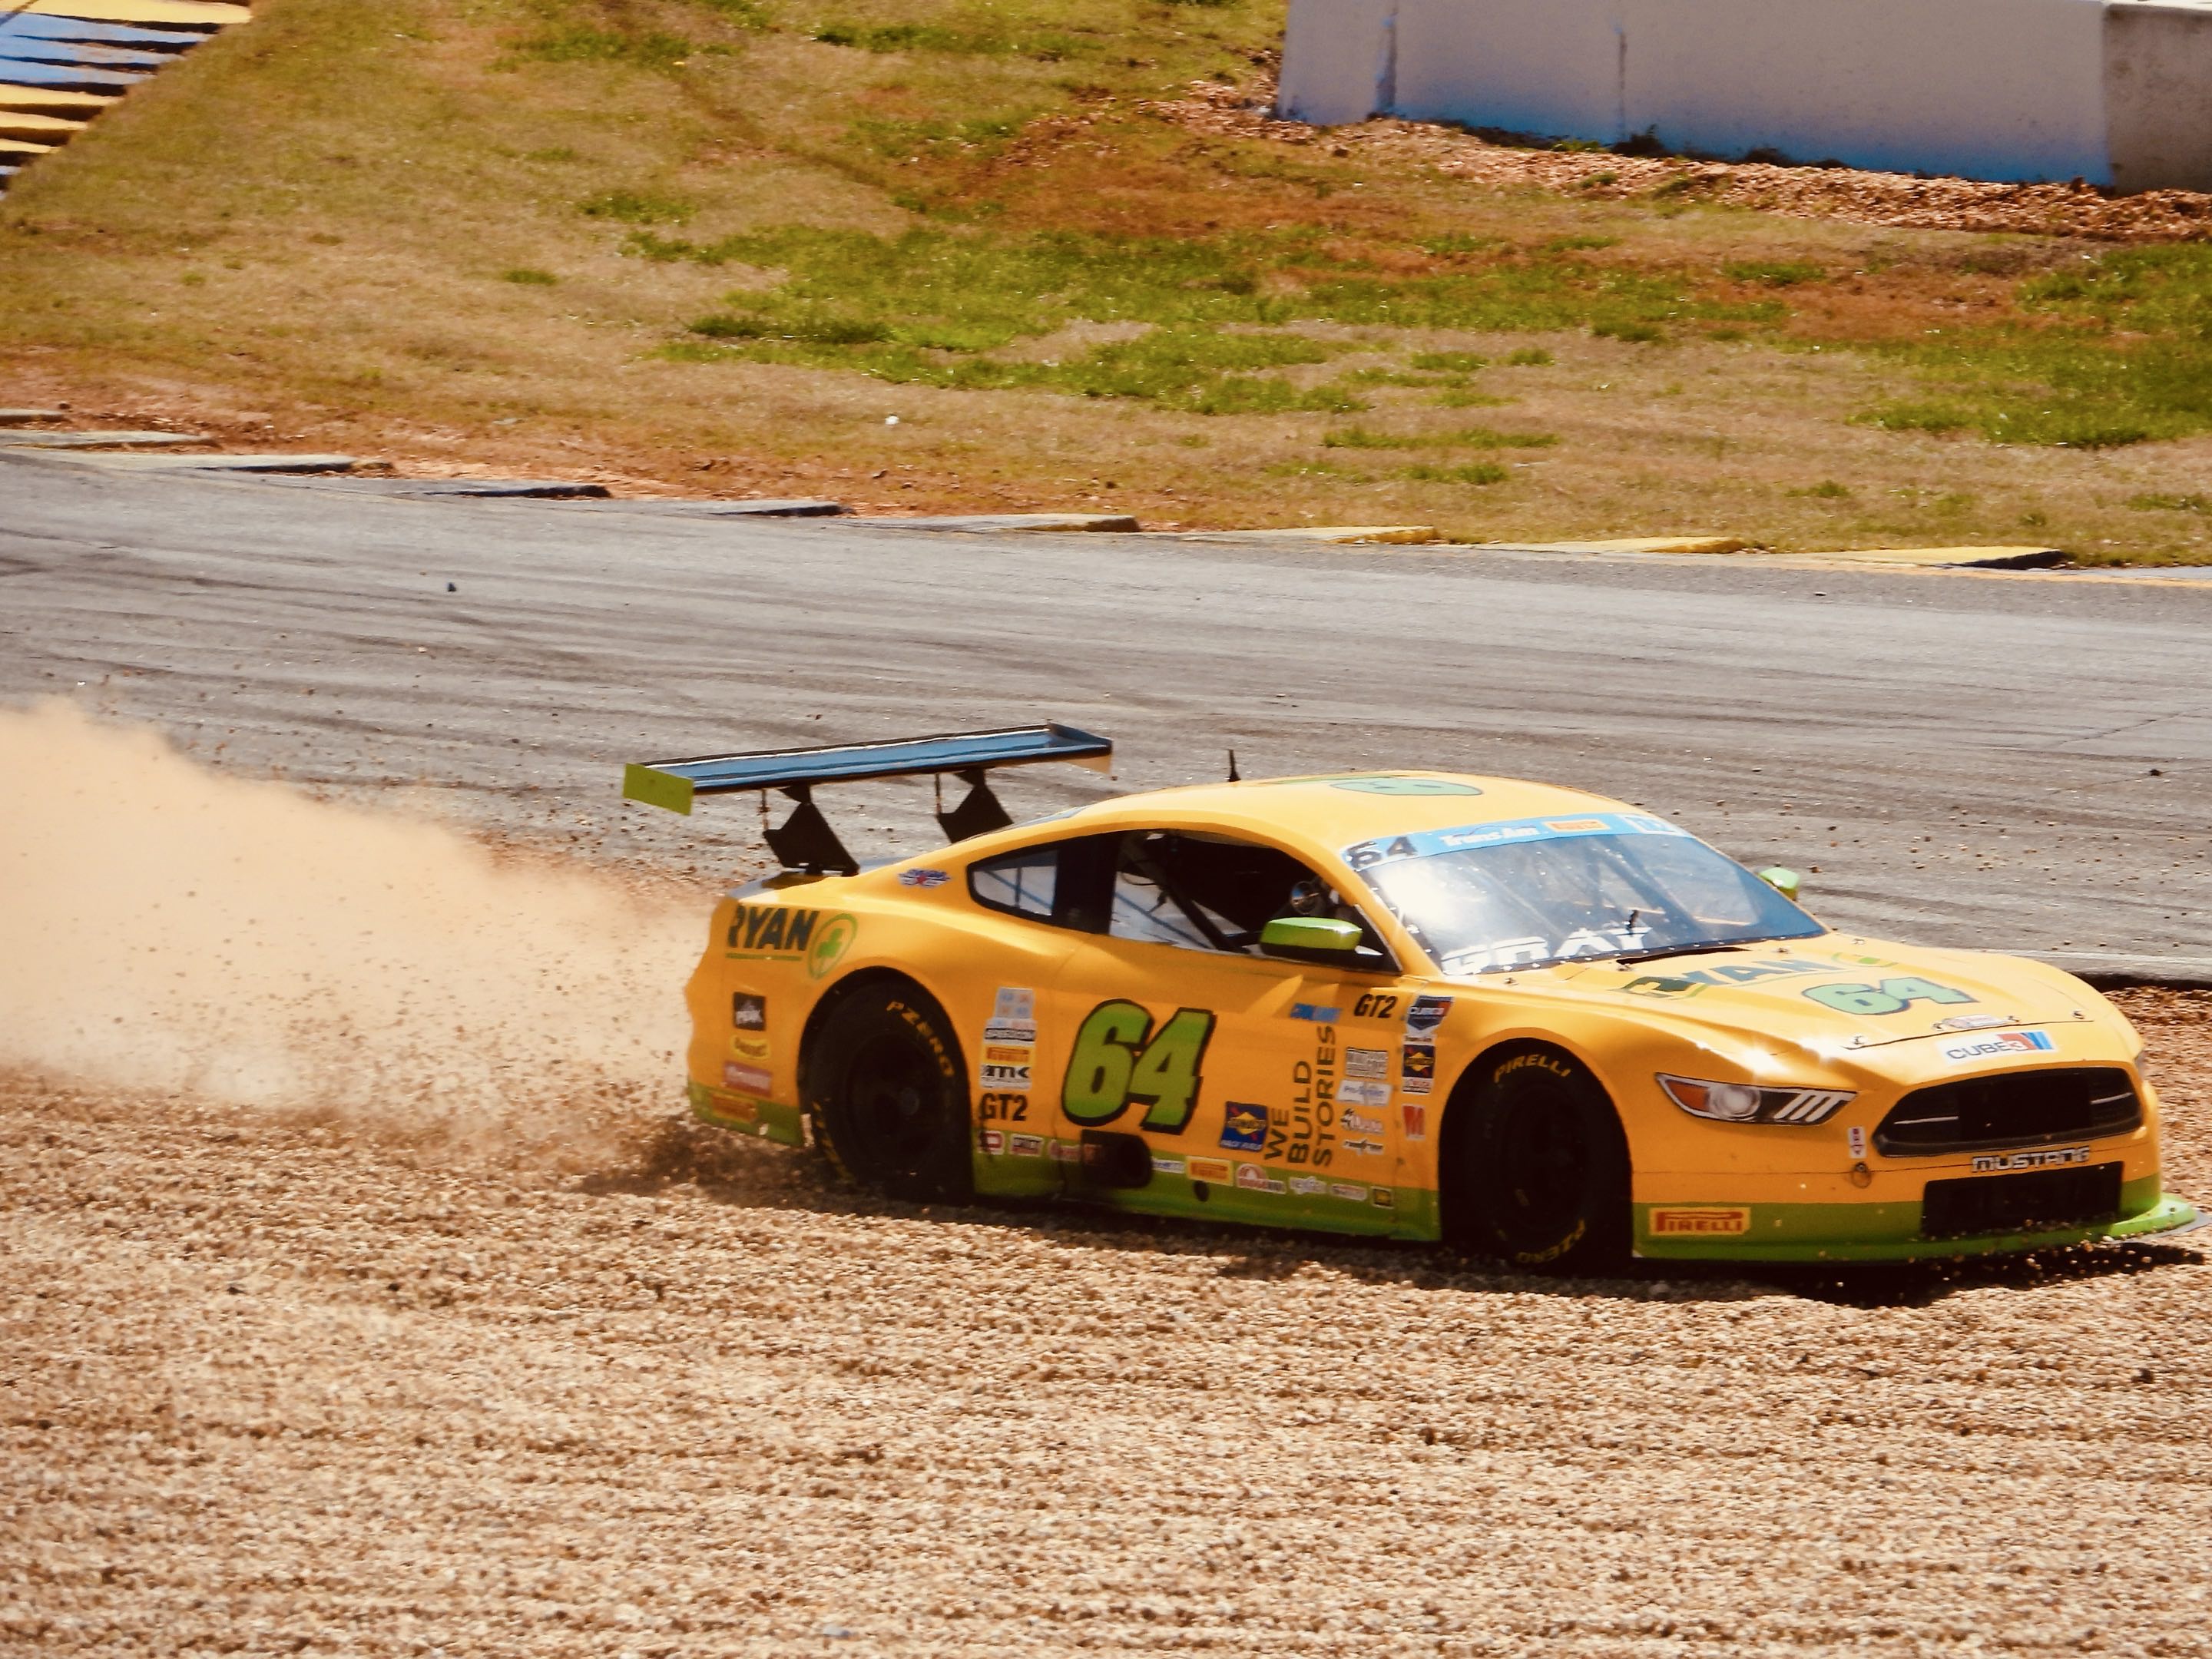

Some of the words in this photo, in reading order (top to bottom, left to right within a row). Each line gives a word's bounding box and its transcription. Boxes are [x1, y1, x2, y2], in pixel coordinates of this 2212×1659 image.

[1346, 836, 1418, 869] 64
[1354, 994, 1399, 1018] GT2
[1801, 977, 1979, 1015] 64
[1061, 998, 1217, 1135] 64
[1493, 1053, 1571, 1084] PIRELLI
[980, 1092, 1028, 1121] GT2
[1287, 1060, 1312, 1164] BUILD
[1313, 1025, 1336, 1167] STORIES
[1263, 1108, 1290, 1160] WE
[1972, 1146, 2090, 1173] MUSTANG
[1656, 1211, 1743, 1231] PIRELLI
